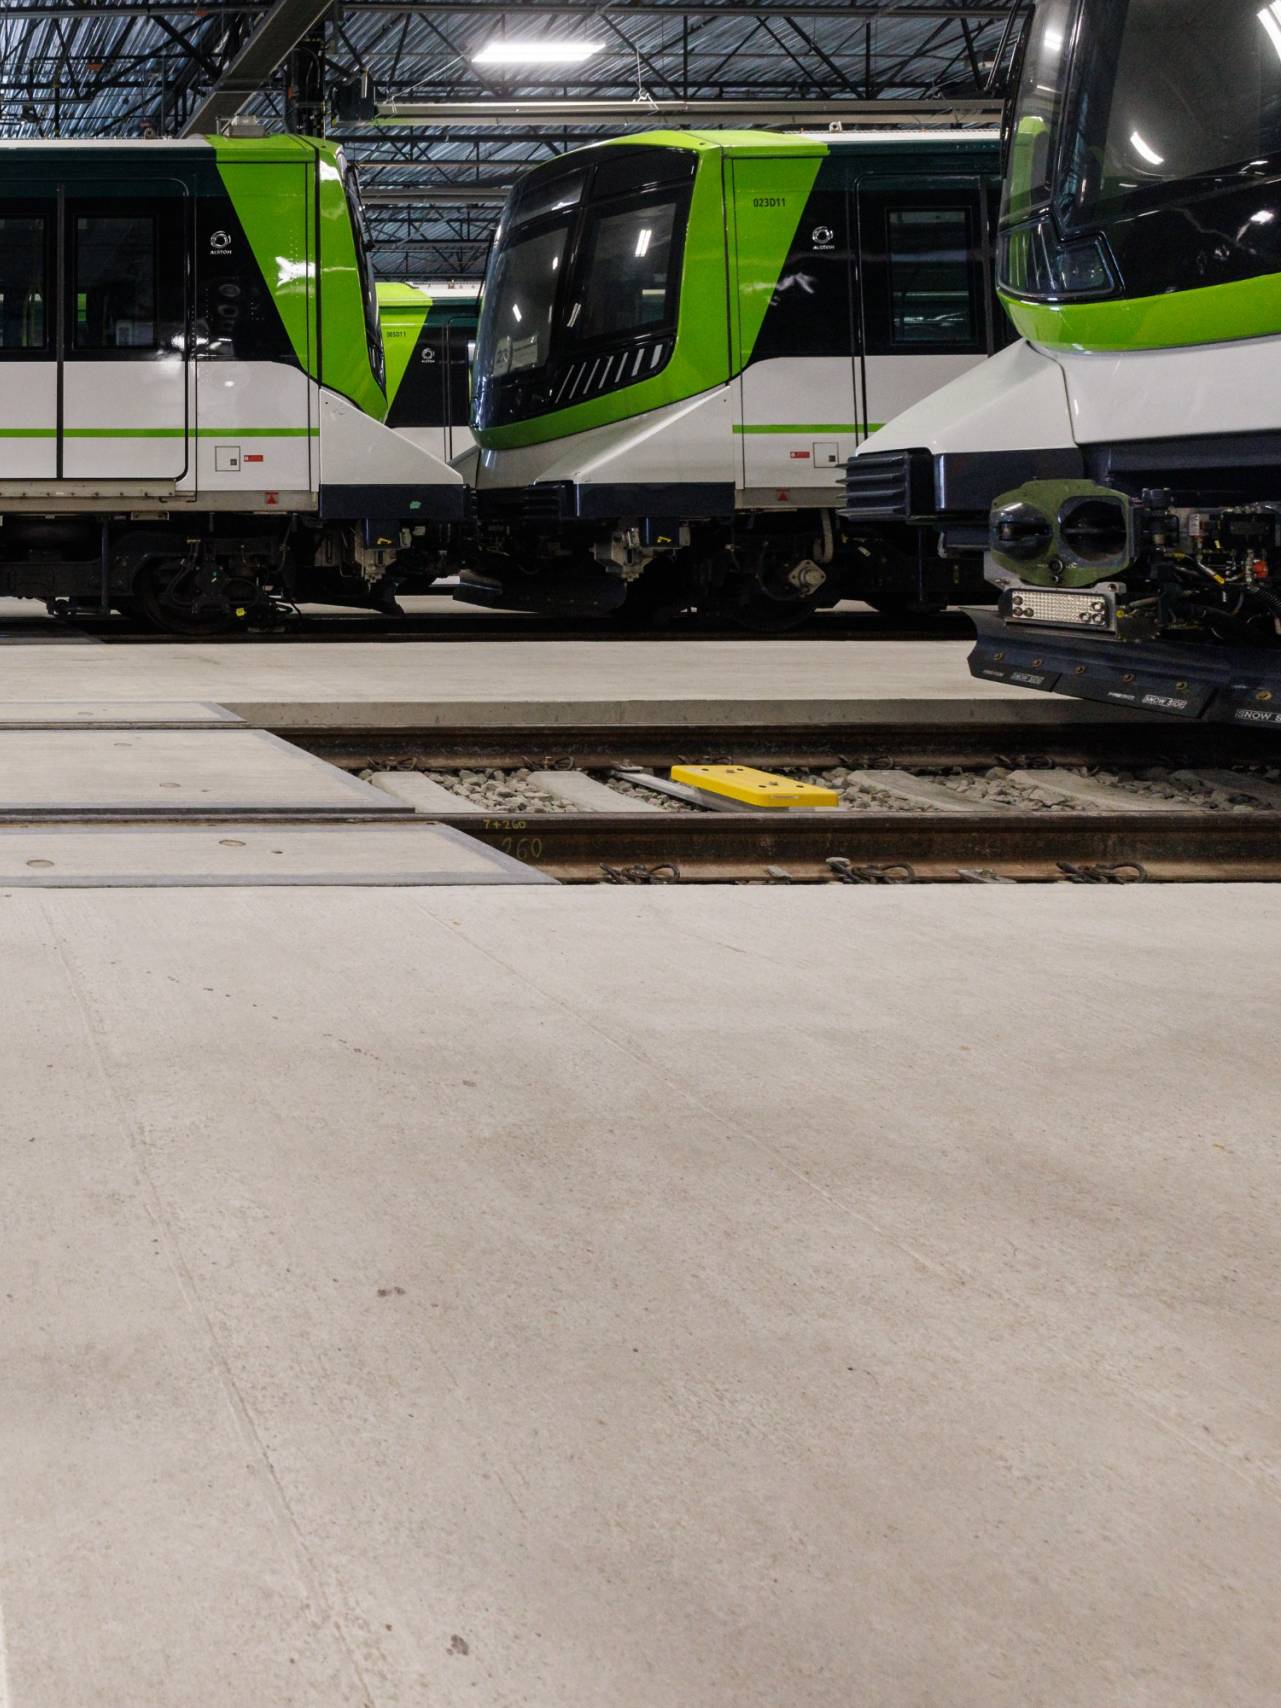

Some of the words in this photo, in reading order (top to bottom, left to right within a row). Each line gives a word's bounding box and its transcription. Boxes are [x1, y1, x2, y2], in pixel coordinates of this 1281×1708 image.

[753, 198, 786, 208] 023D11
[1236, 710, 1272, 721] SNOW
[483, 817, 526, 830] 7+260
